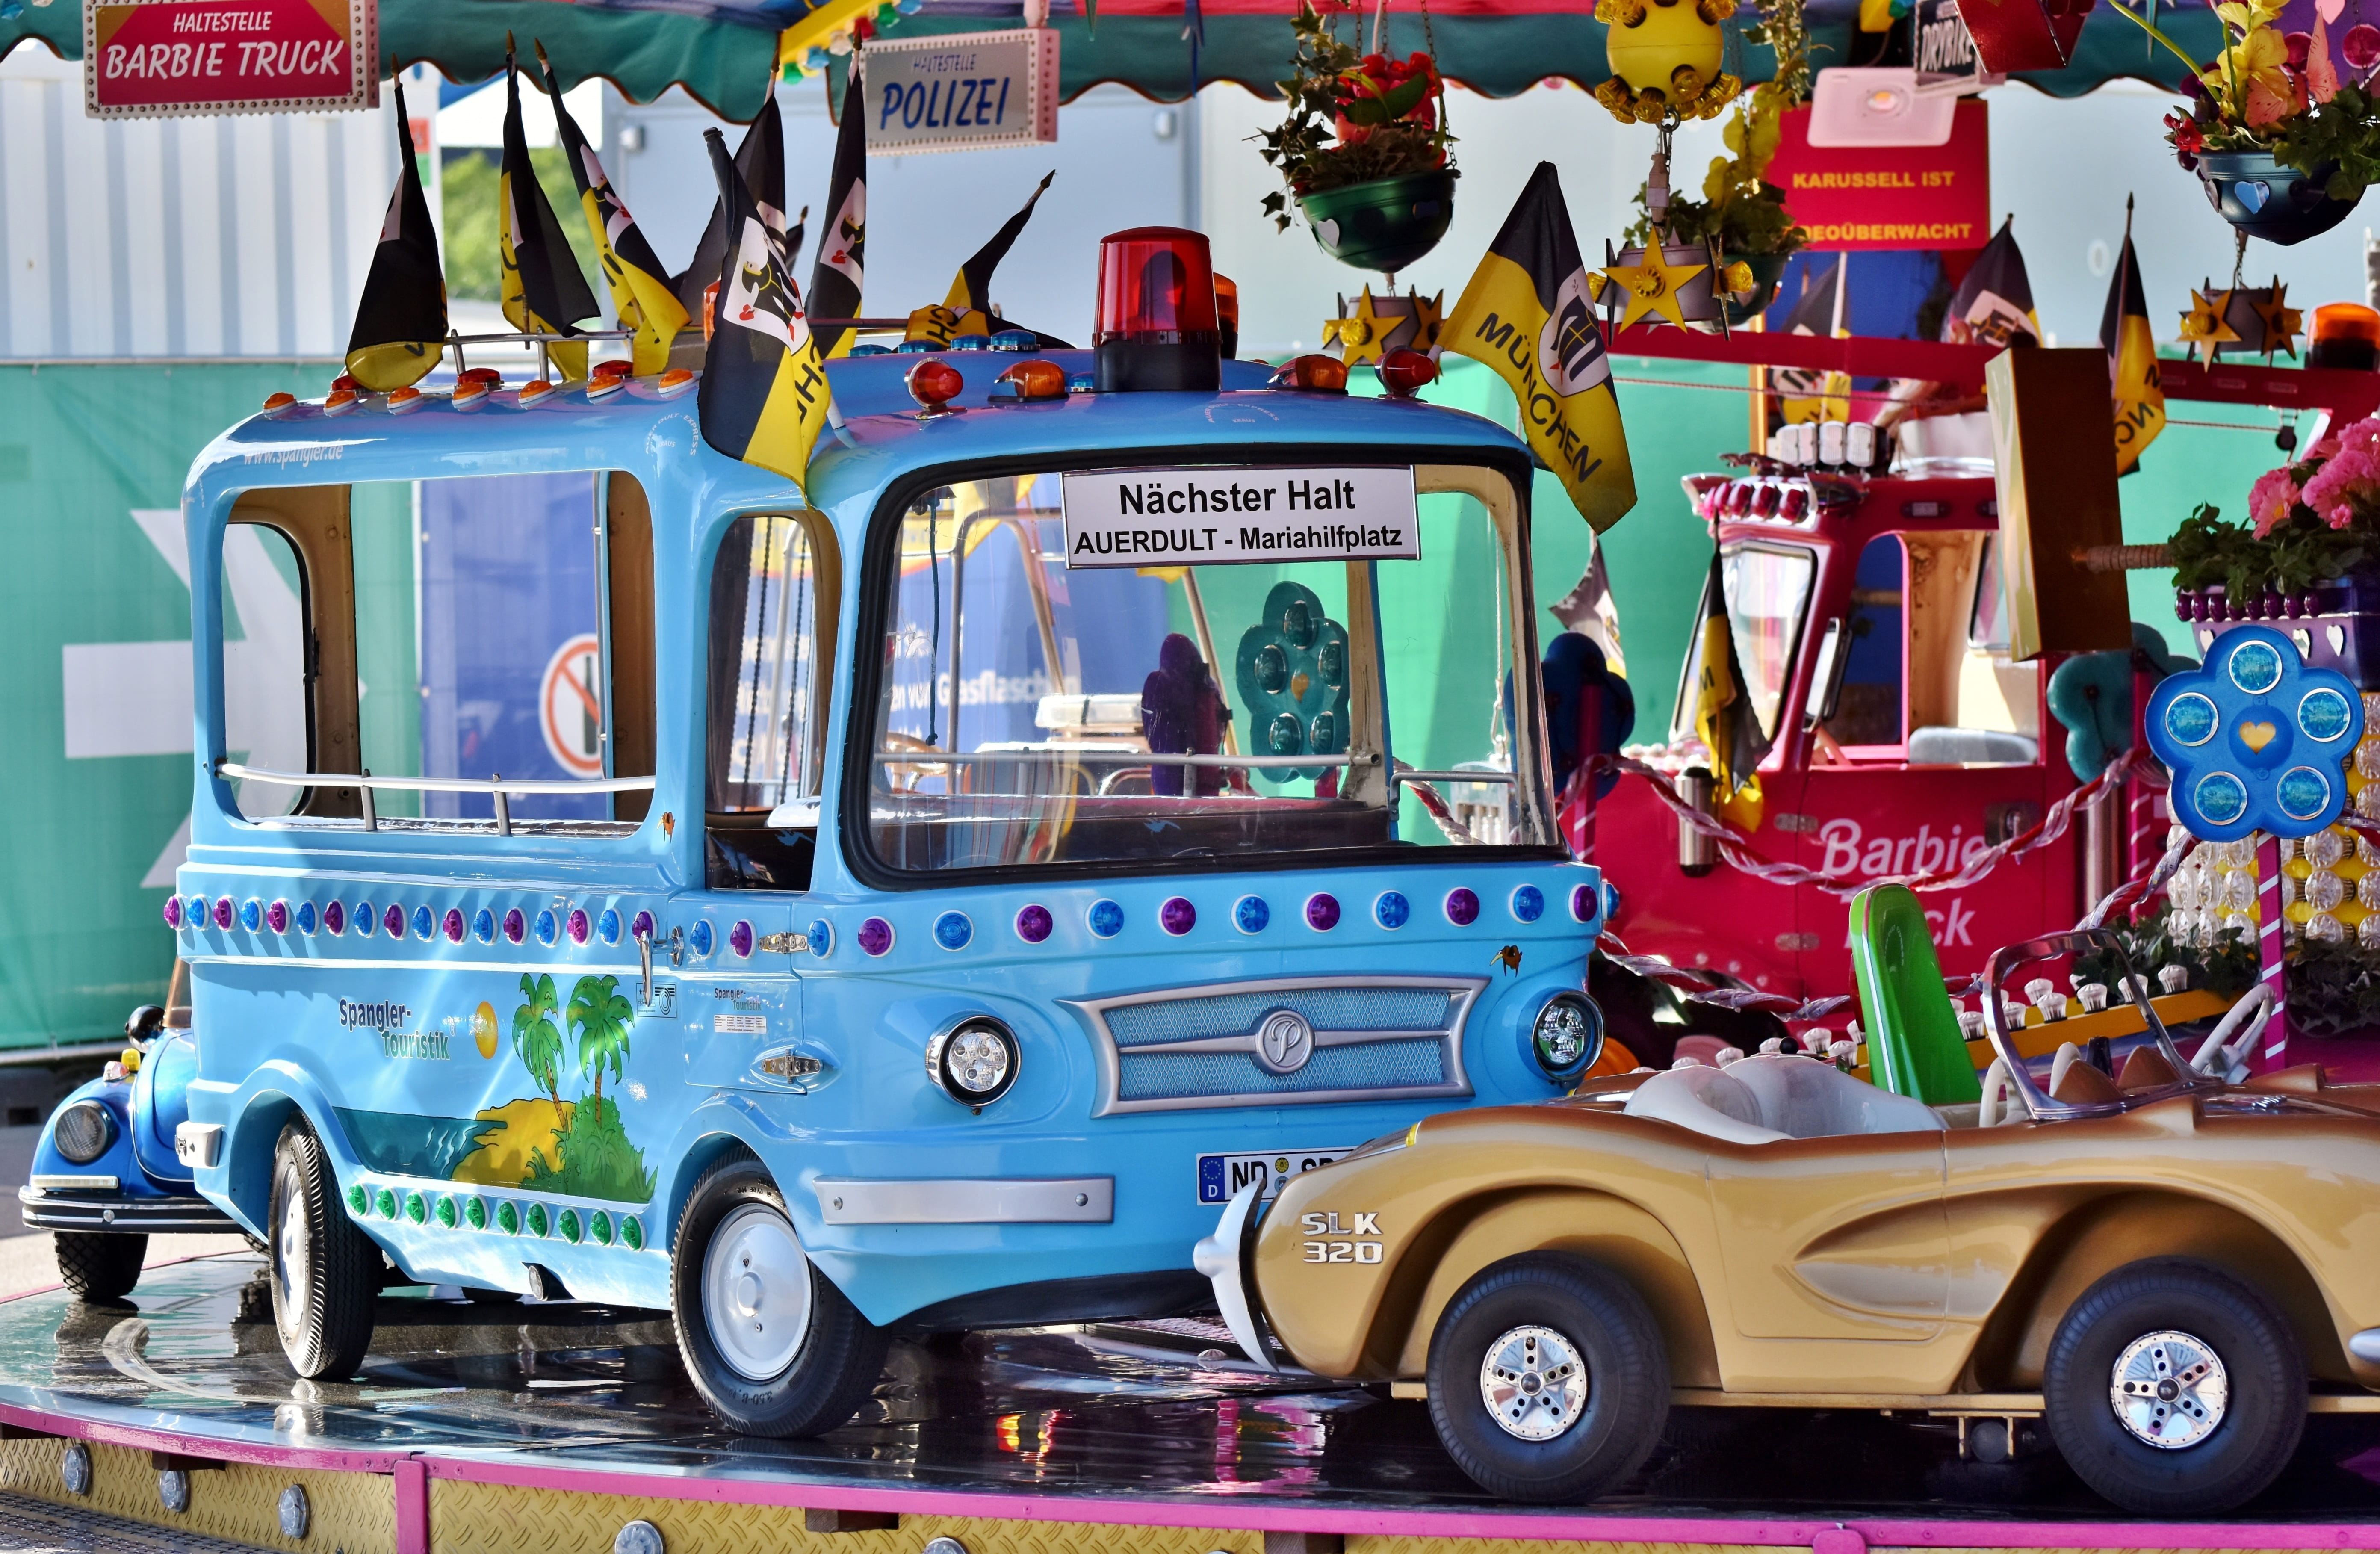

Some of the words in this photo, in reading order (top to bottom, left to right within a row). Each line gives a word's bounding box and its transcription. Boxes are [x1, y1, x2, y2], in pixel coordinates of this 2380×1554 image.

[173, 11, 273, 33] HALTESTELLE
[105, 42, 226, 80] BARBIE
[237, 39, 344, 77] TRUCK
[912, 53, 977, 73] HALTESTELLE
[880, 77, 1010, 130] POLIZEI
[1792, 172, 1915, 188] KARUSSELL
[1922, 171, 1955, 186] IST
[1799, 222, 1973, 241] DEOÜBERWACHT
[1476, 313, 1602, 482] MÜNCHEN
[683, 414, 699, 456] EXPRESS
[244, 438, 343, 470] www.spangler.de
[1119, 481, 1276, 515] Nächster
[1287, 479, 1356, 511] Halt
[1074, 529, 1218, 555] AUERDULT
[1240, 524, 1403, 552] Mariahilfplatz
[1820, 818, 1986, 876] Barbie
[715, 988, 746, 1001] Spangler-
[732, 1000, 762, 1010] Touristik
[340, 998, 412, 1032] Spangler-
[382, 1029, 450, 1060] Touristik
[1208, 1184, 1218, 1197] D
[1232, 1161, 1267, 1193] ND
[1302, 1211, 1382, 1236] SLK
[1303, 1241, 1383, 1263] 320
